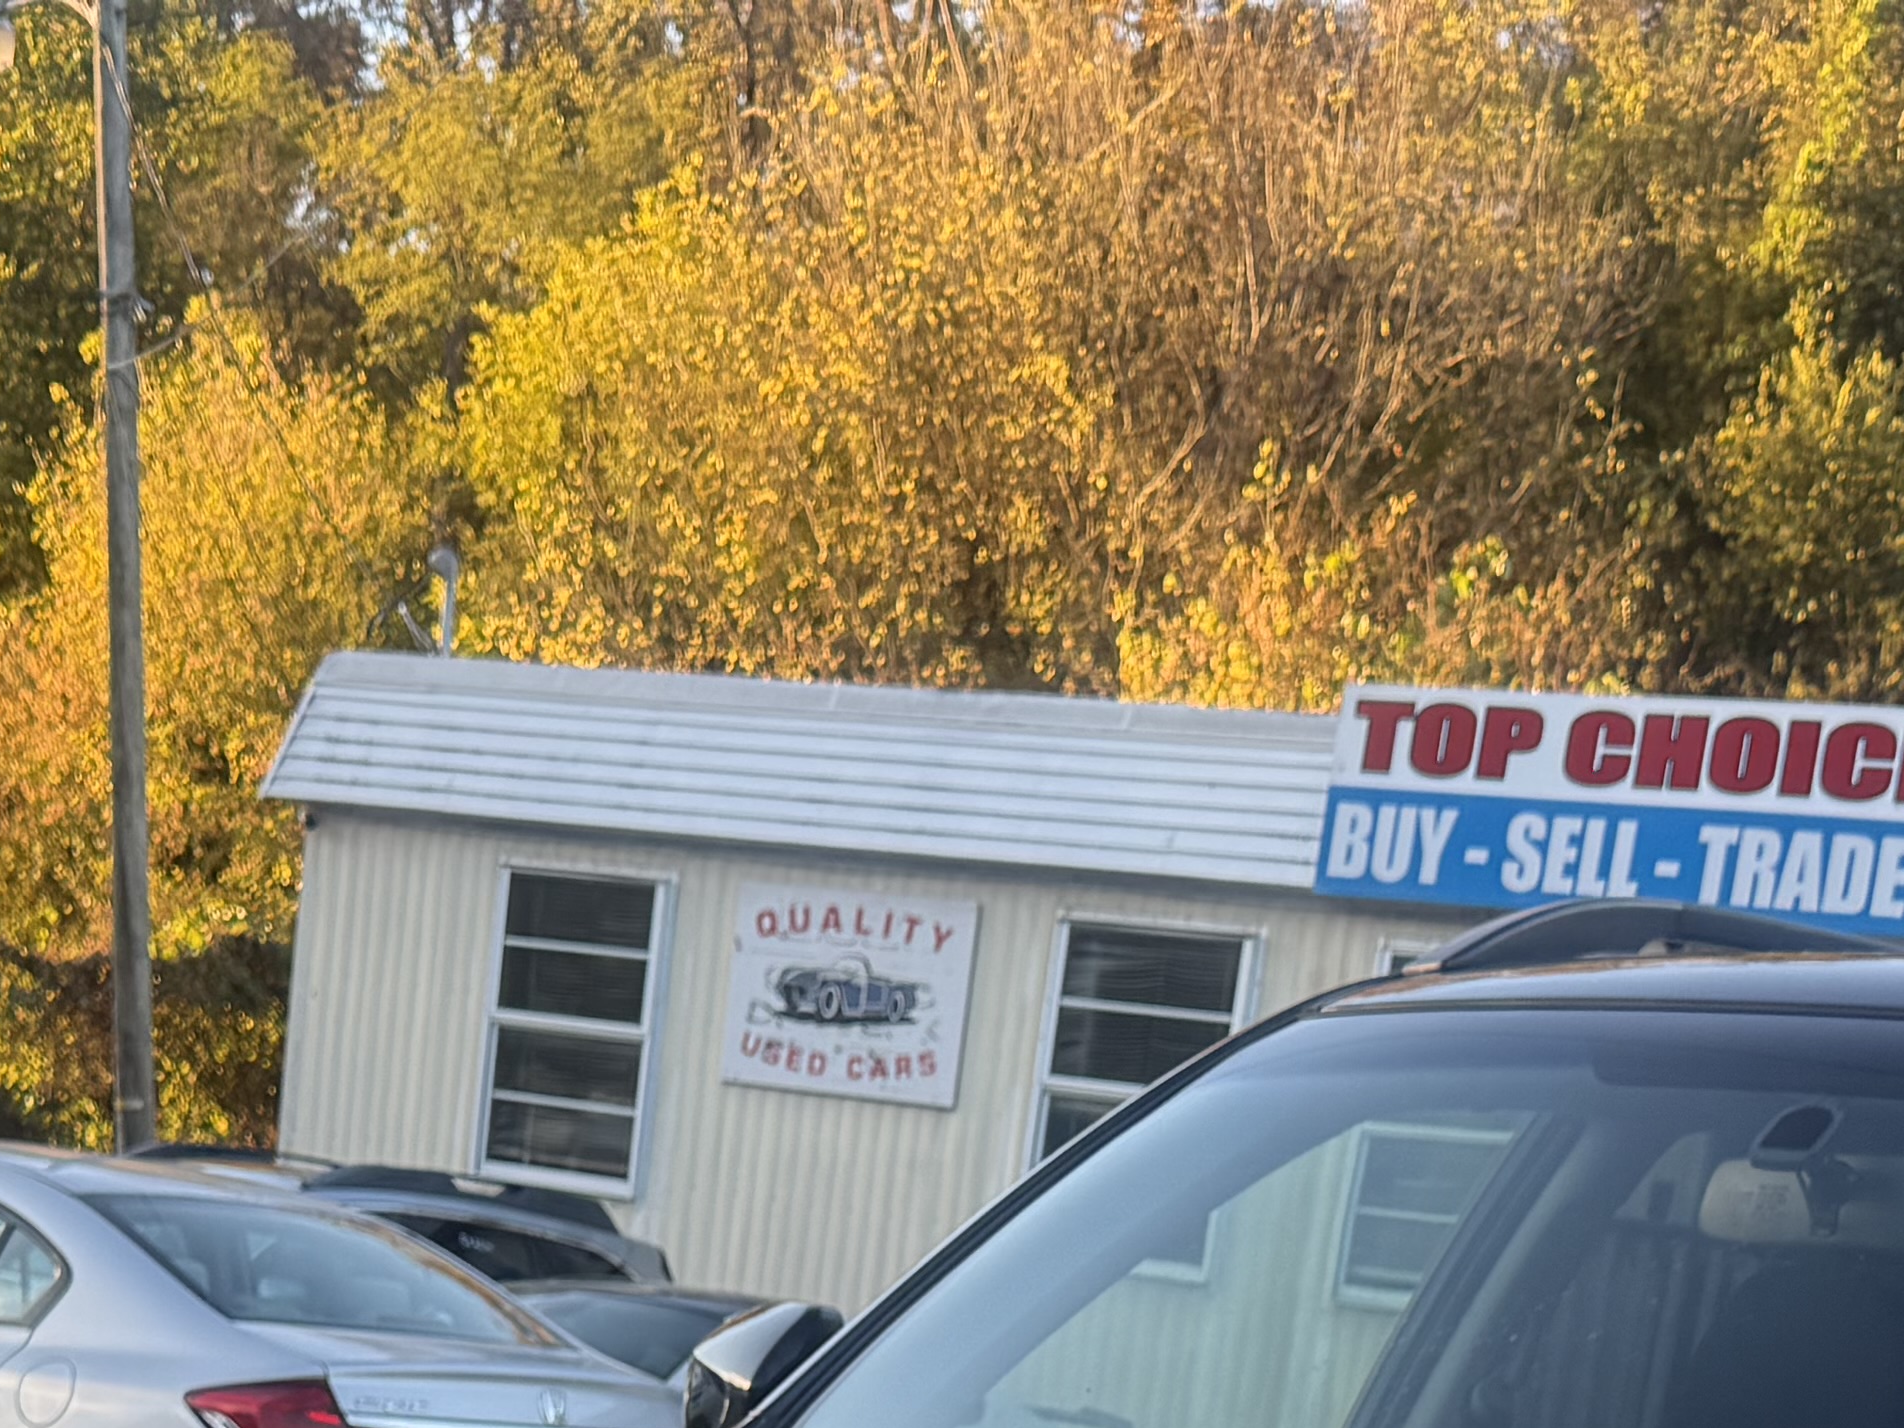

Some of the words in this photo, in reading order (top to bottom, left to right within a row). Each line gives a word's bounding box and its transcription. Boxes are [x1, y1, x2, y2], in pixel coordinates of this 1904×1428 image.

[1356, 700, 1543, 779] TOP
[1325, 800, 1460, 886] BUY
[1501, 811, 1640, 899] SELL
[755, 903, 954, 954] QUALITY
[740, 1031, 827, 1077] USED
[846, 1048, 938, 1082] CARS
